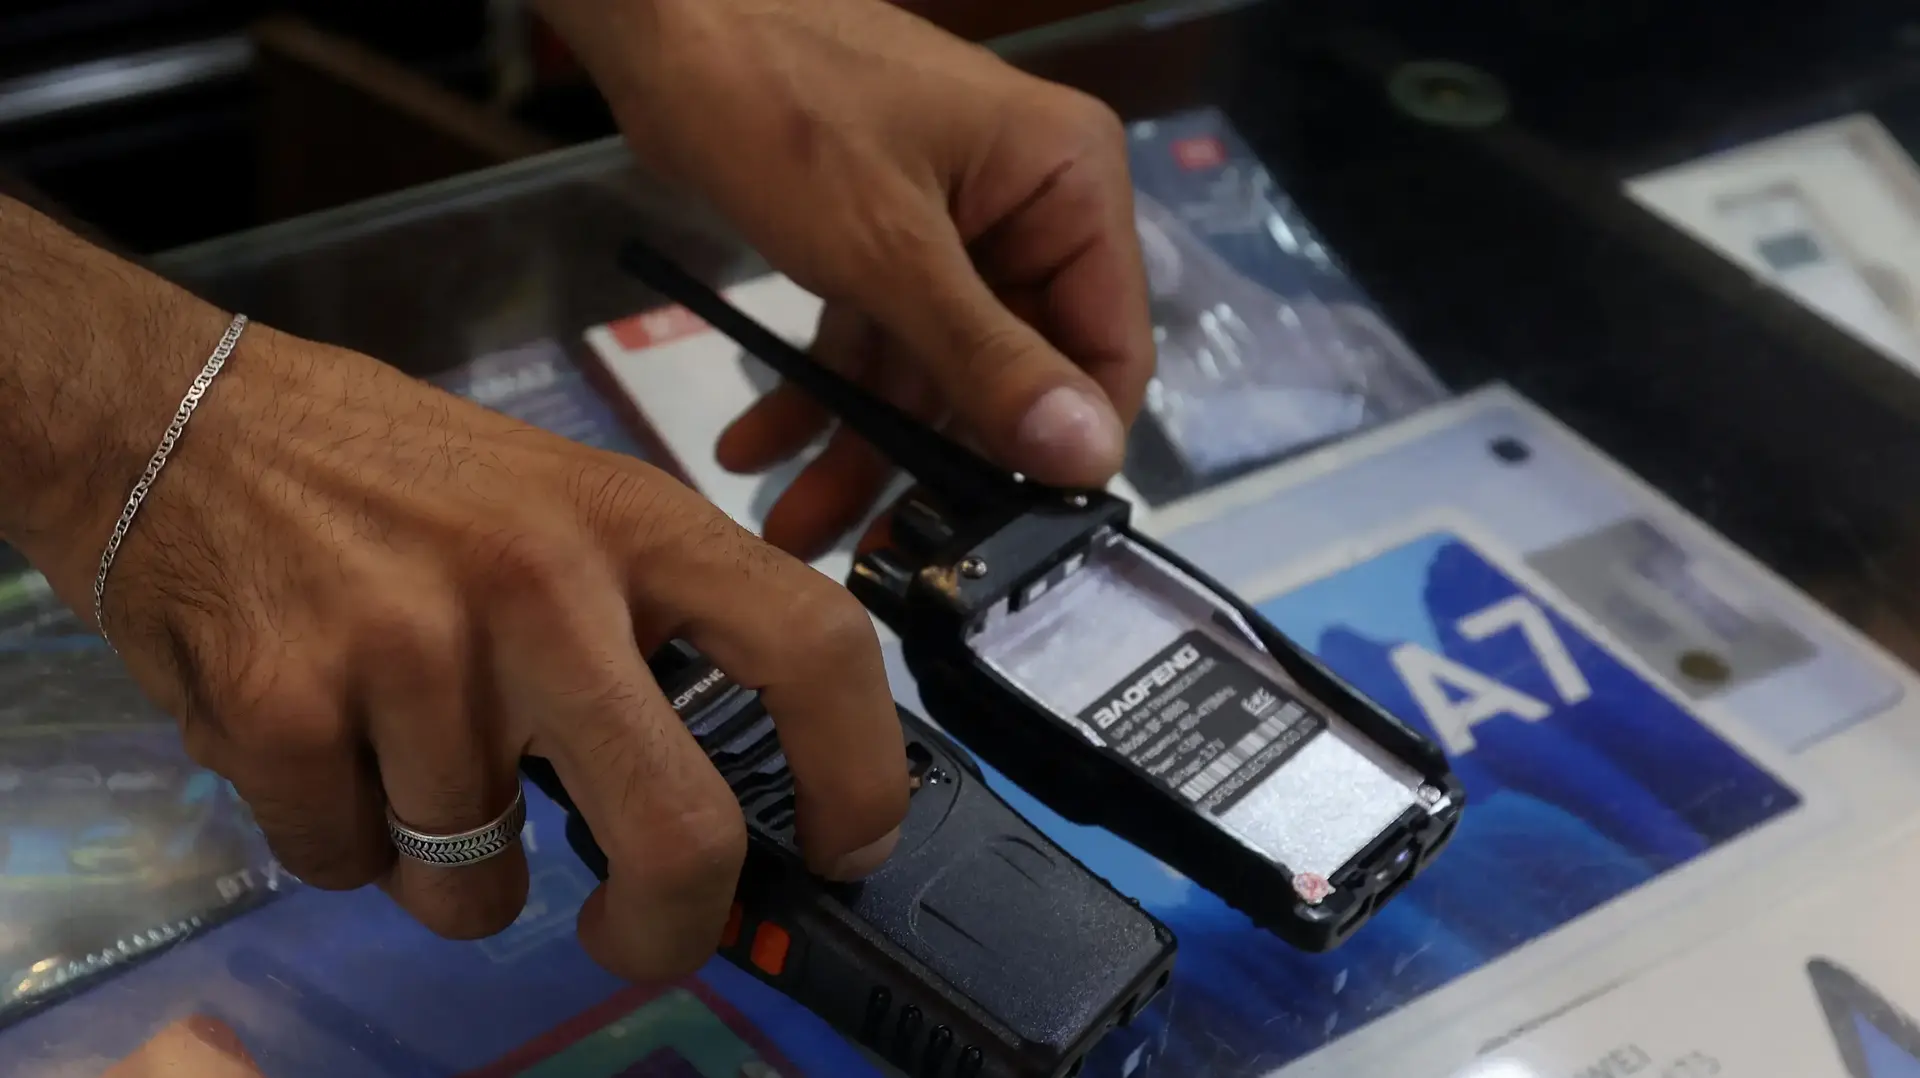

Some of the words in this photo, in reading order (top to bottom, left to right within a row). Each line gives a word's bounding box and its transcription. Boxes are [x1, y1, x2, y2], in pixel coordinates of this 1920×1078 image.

[672, 668, 725, 710] OFENG
[1092, 643, 1201, 729] BAOFENG
[1389, 594, 1592, 757] A7
